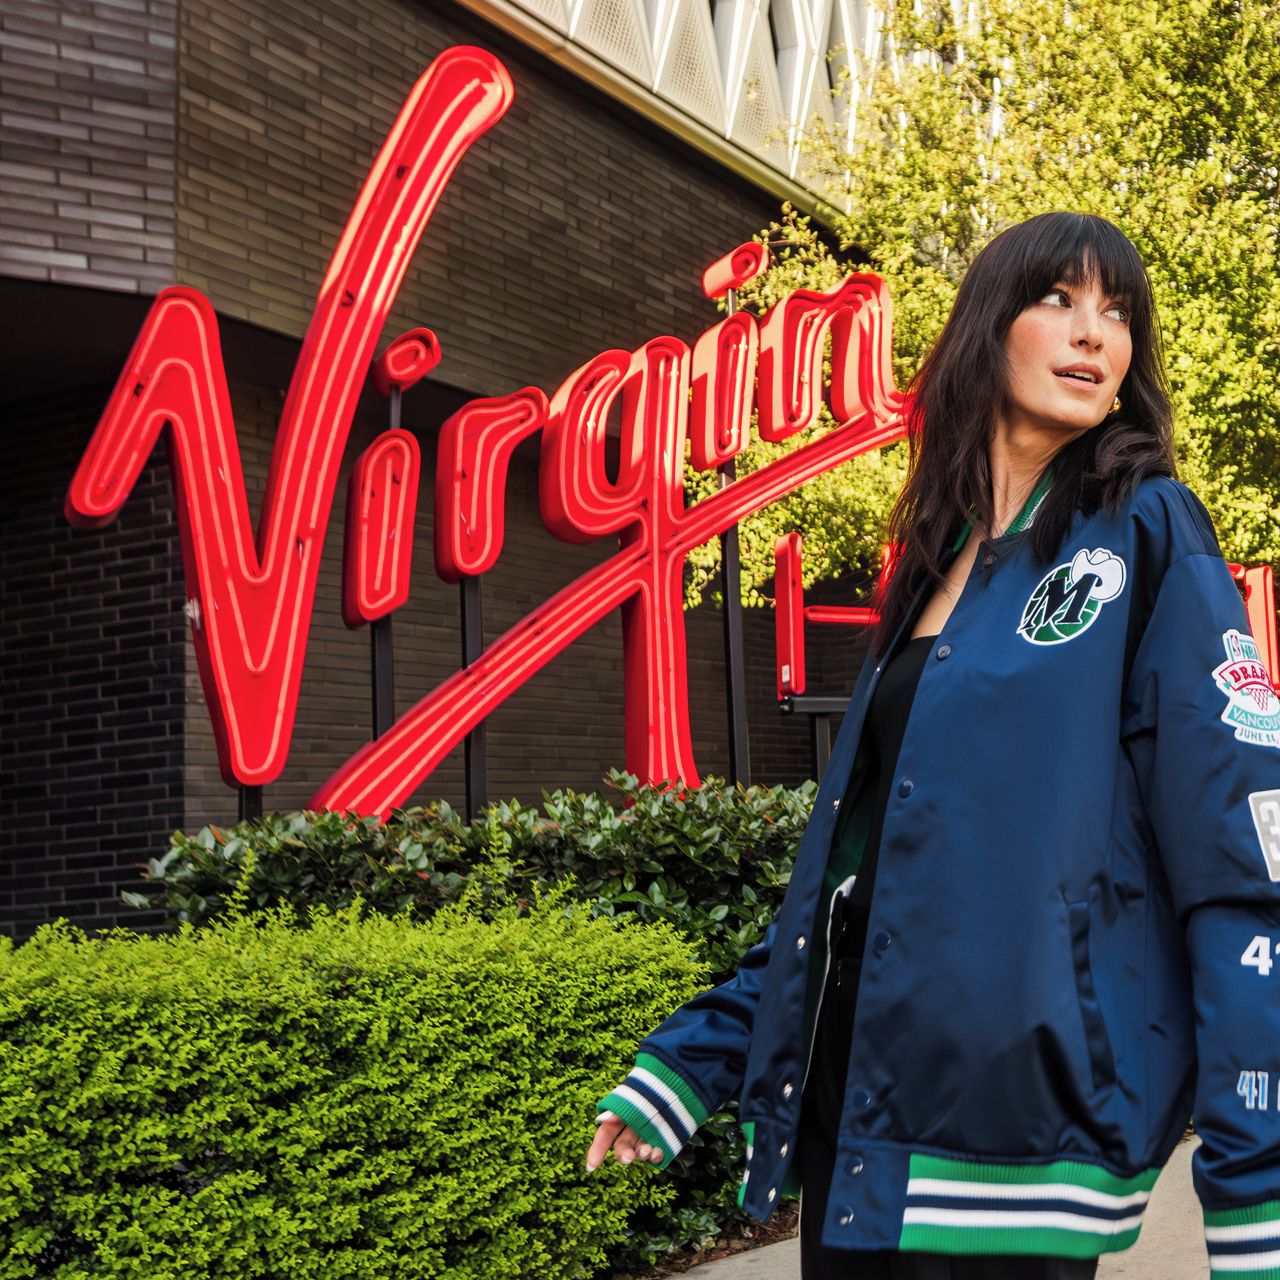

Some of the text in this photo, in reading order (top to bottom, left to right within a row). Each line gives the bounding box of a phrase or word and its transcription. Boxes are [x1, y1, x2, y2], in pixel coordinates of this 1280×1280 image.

[66, 45, 914, 818] Virgin
[1229, 664, 1268, 684] DRAF
[1238, 727, 1263, 742] JUNE
[1236, 1070, 1269, 1111] 41
